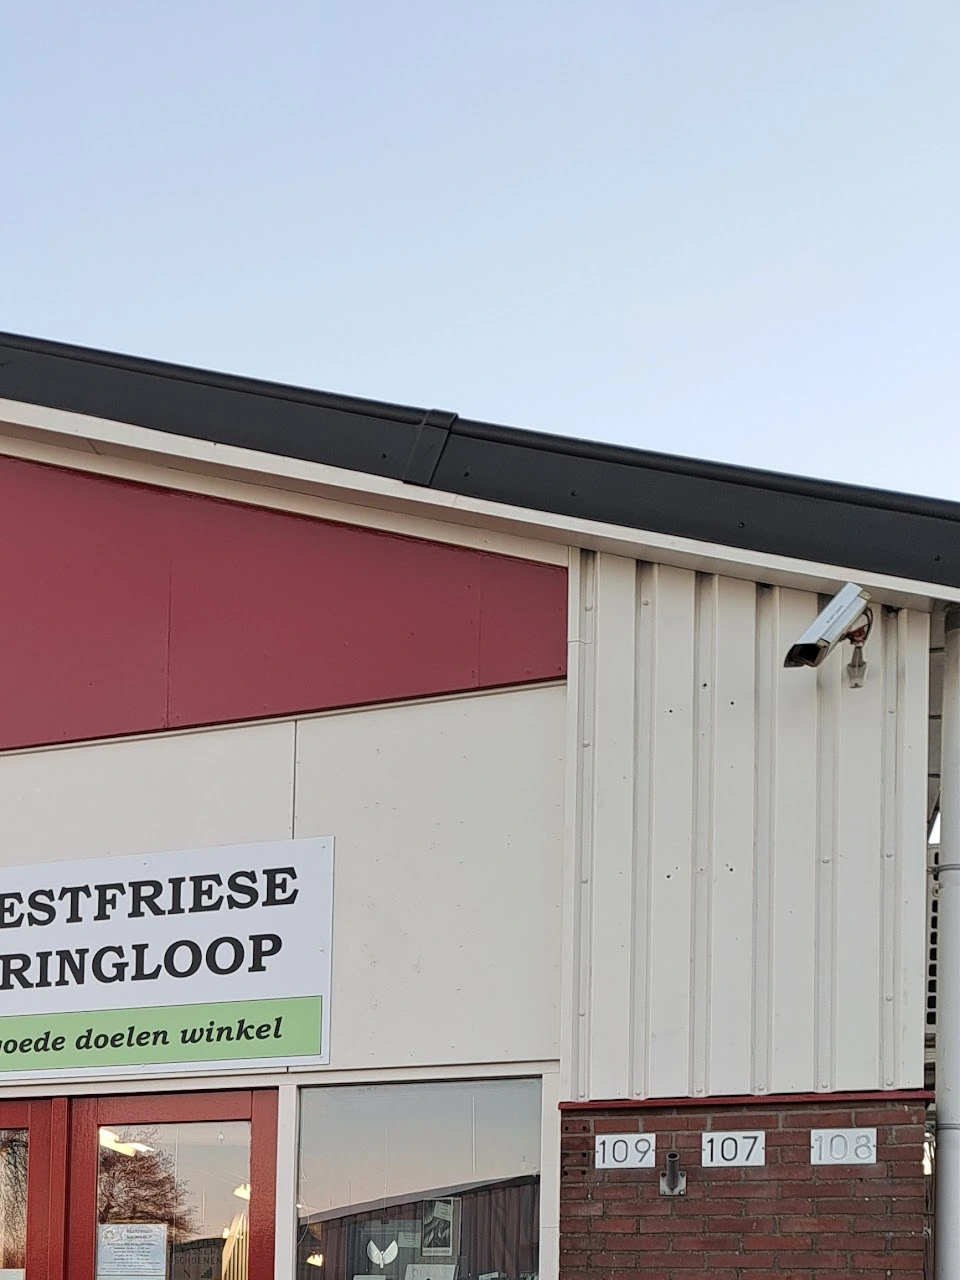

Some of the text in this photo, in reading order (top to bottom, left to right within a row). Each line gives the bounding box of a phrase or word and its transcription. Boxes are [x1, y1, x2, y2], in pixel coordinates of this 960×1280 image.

[75, 1025, 170, 1051] doelen
[180, 1017, 283, 1045] winkel
[598, 1138, 653, 1164] 109
[706, 1135, 759, 1162] 107
[813, 1134, 873, 1161] 108
[175, 1256, 222, 1265] SCHOENEN
